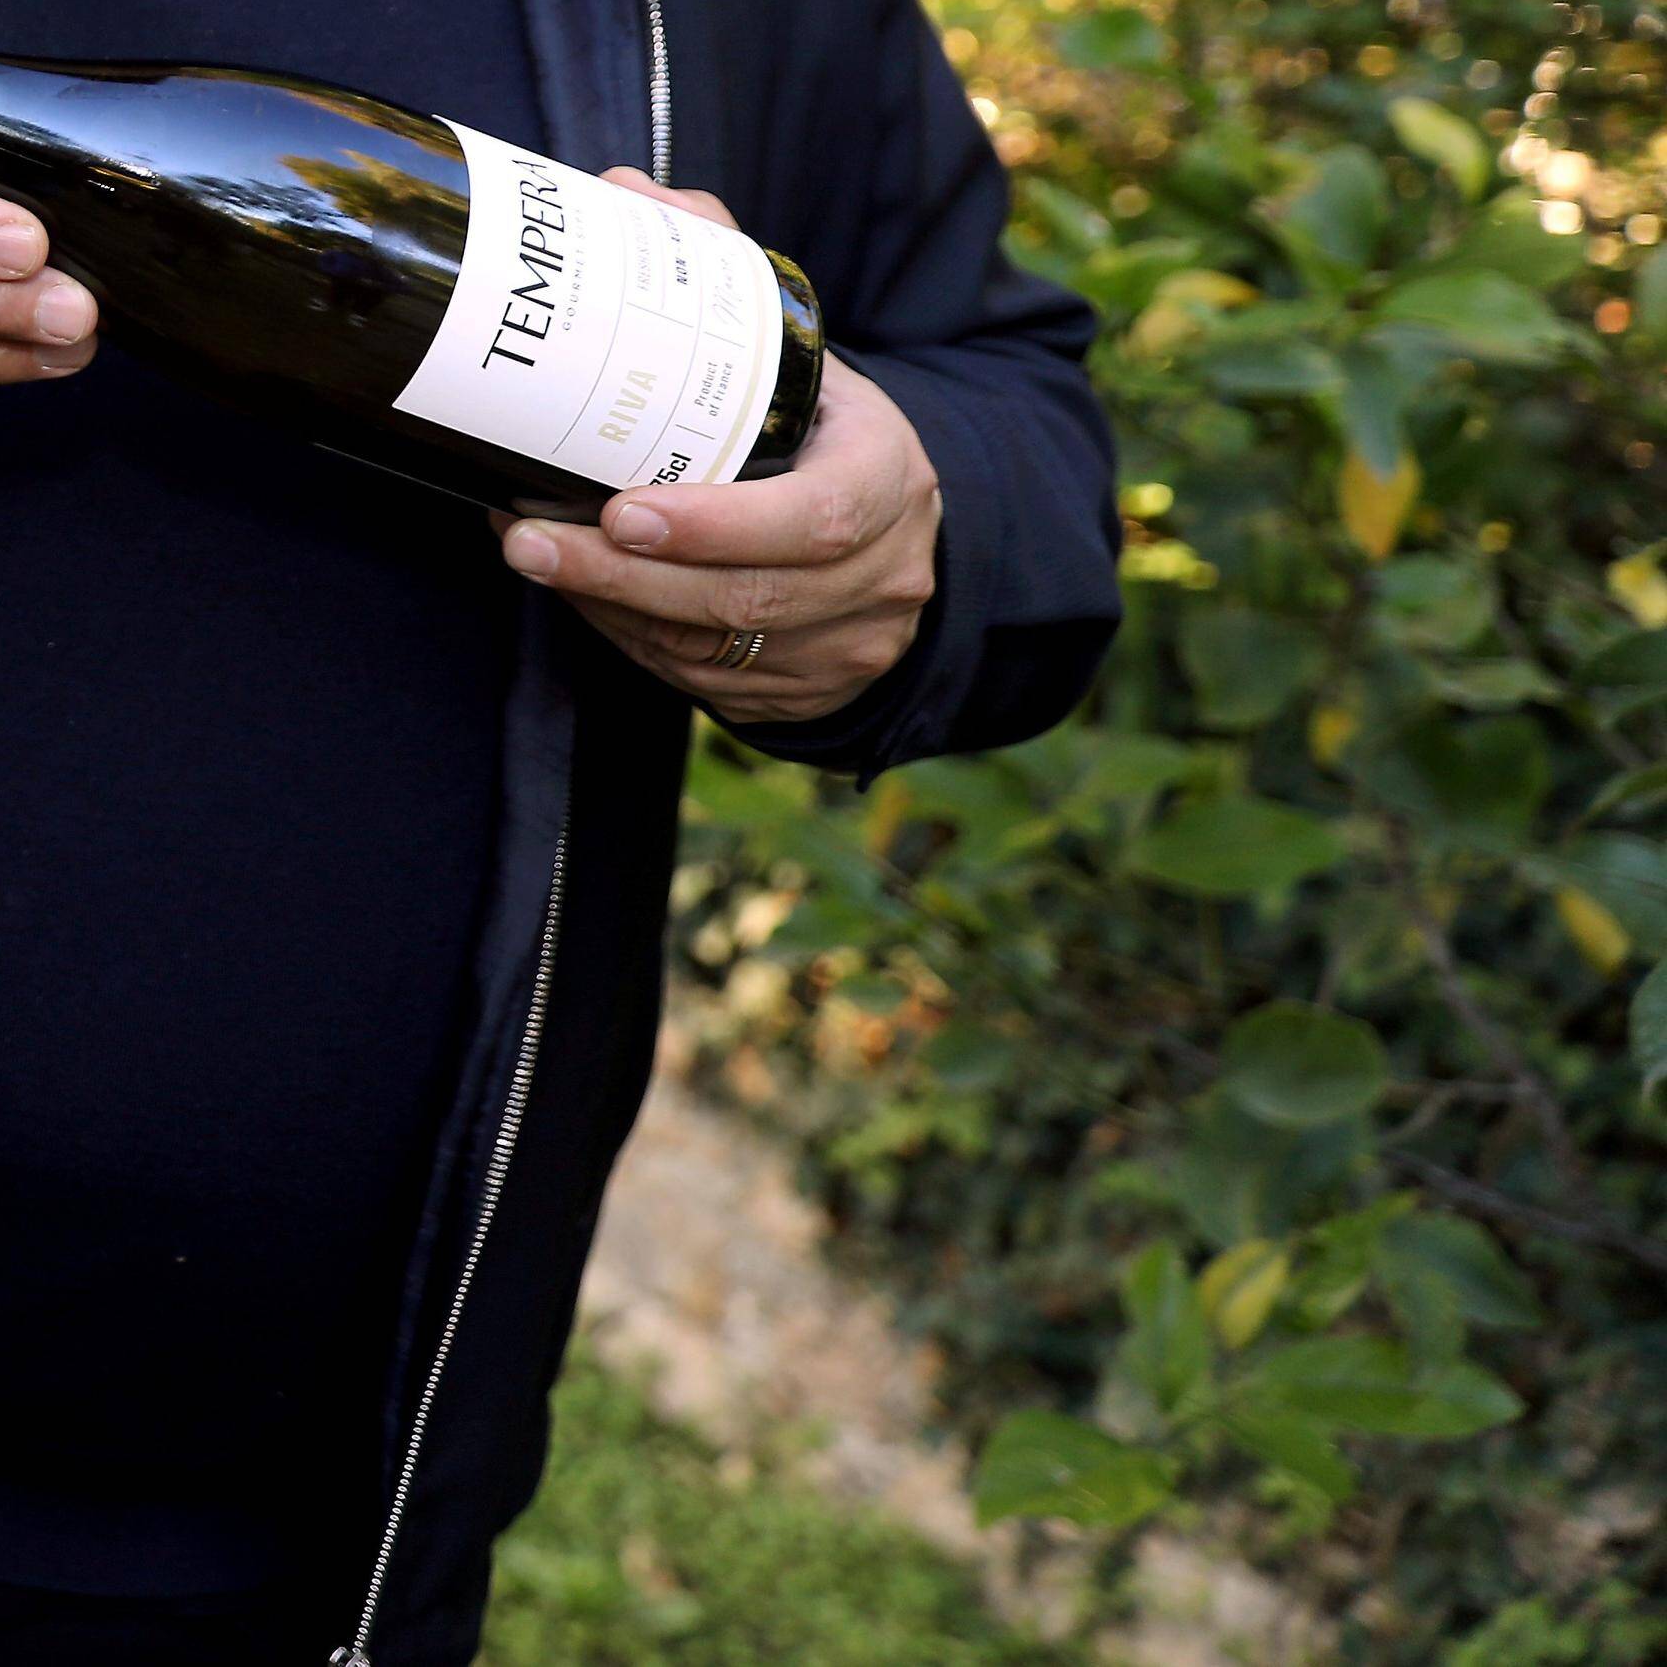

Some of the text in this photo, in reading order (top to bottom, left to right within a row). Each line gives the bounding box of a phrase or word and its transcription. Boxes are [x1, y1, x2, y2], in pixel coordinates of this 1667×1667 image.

[482, 159, 565, 370] TEMPERA
[597, 368, 658, 445] RIVA
[694, 361, 719, 407] Product
[708, 362, 734, 418] of France
